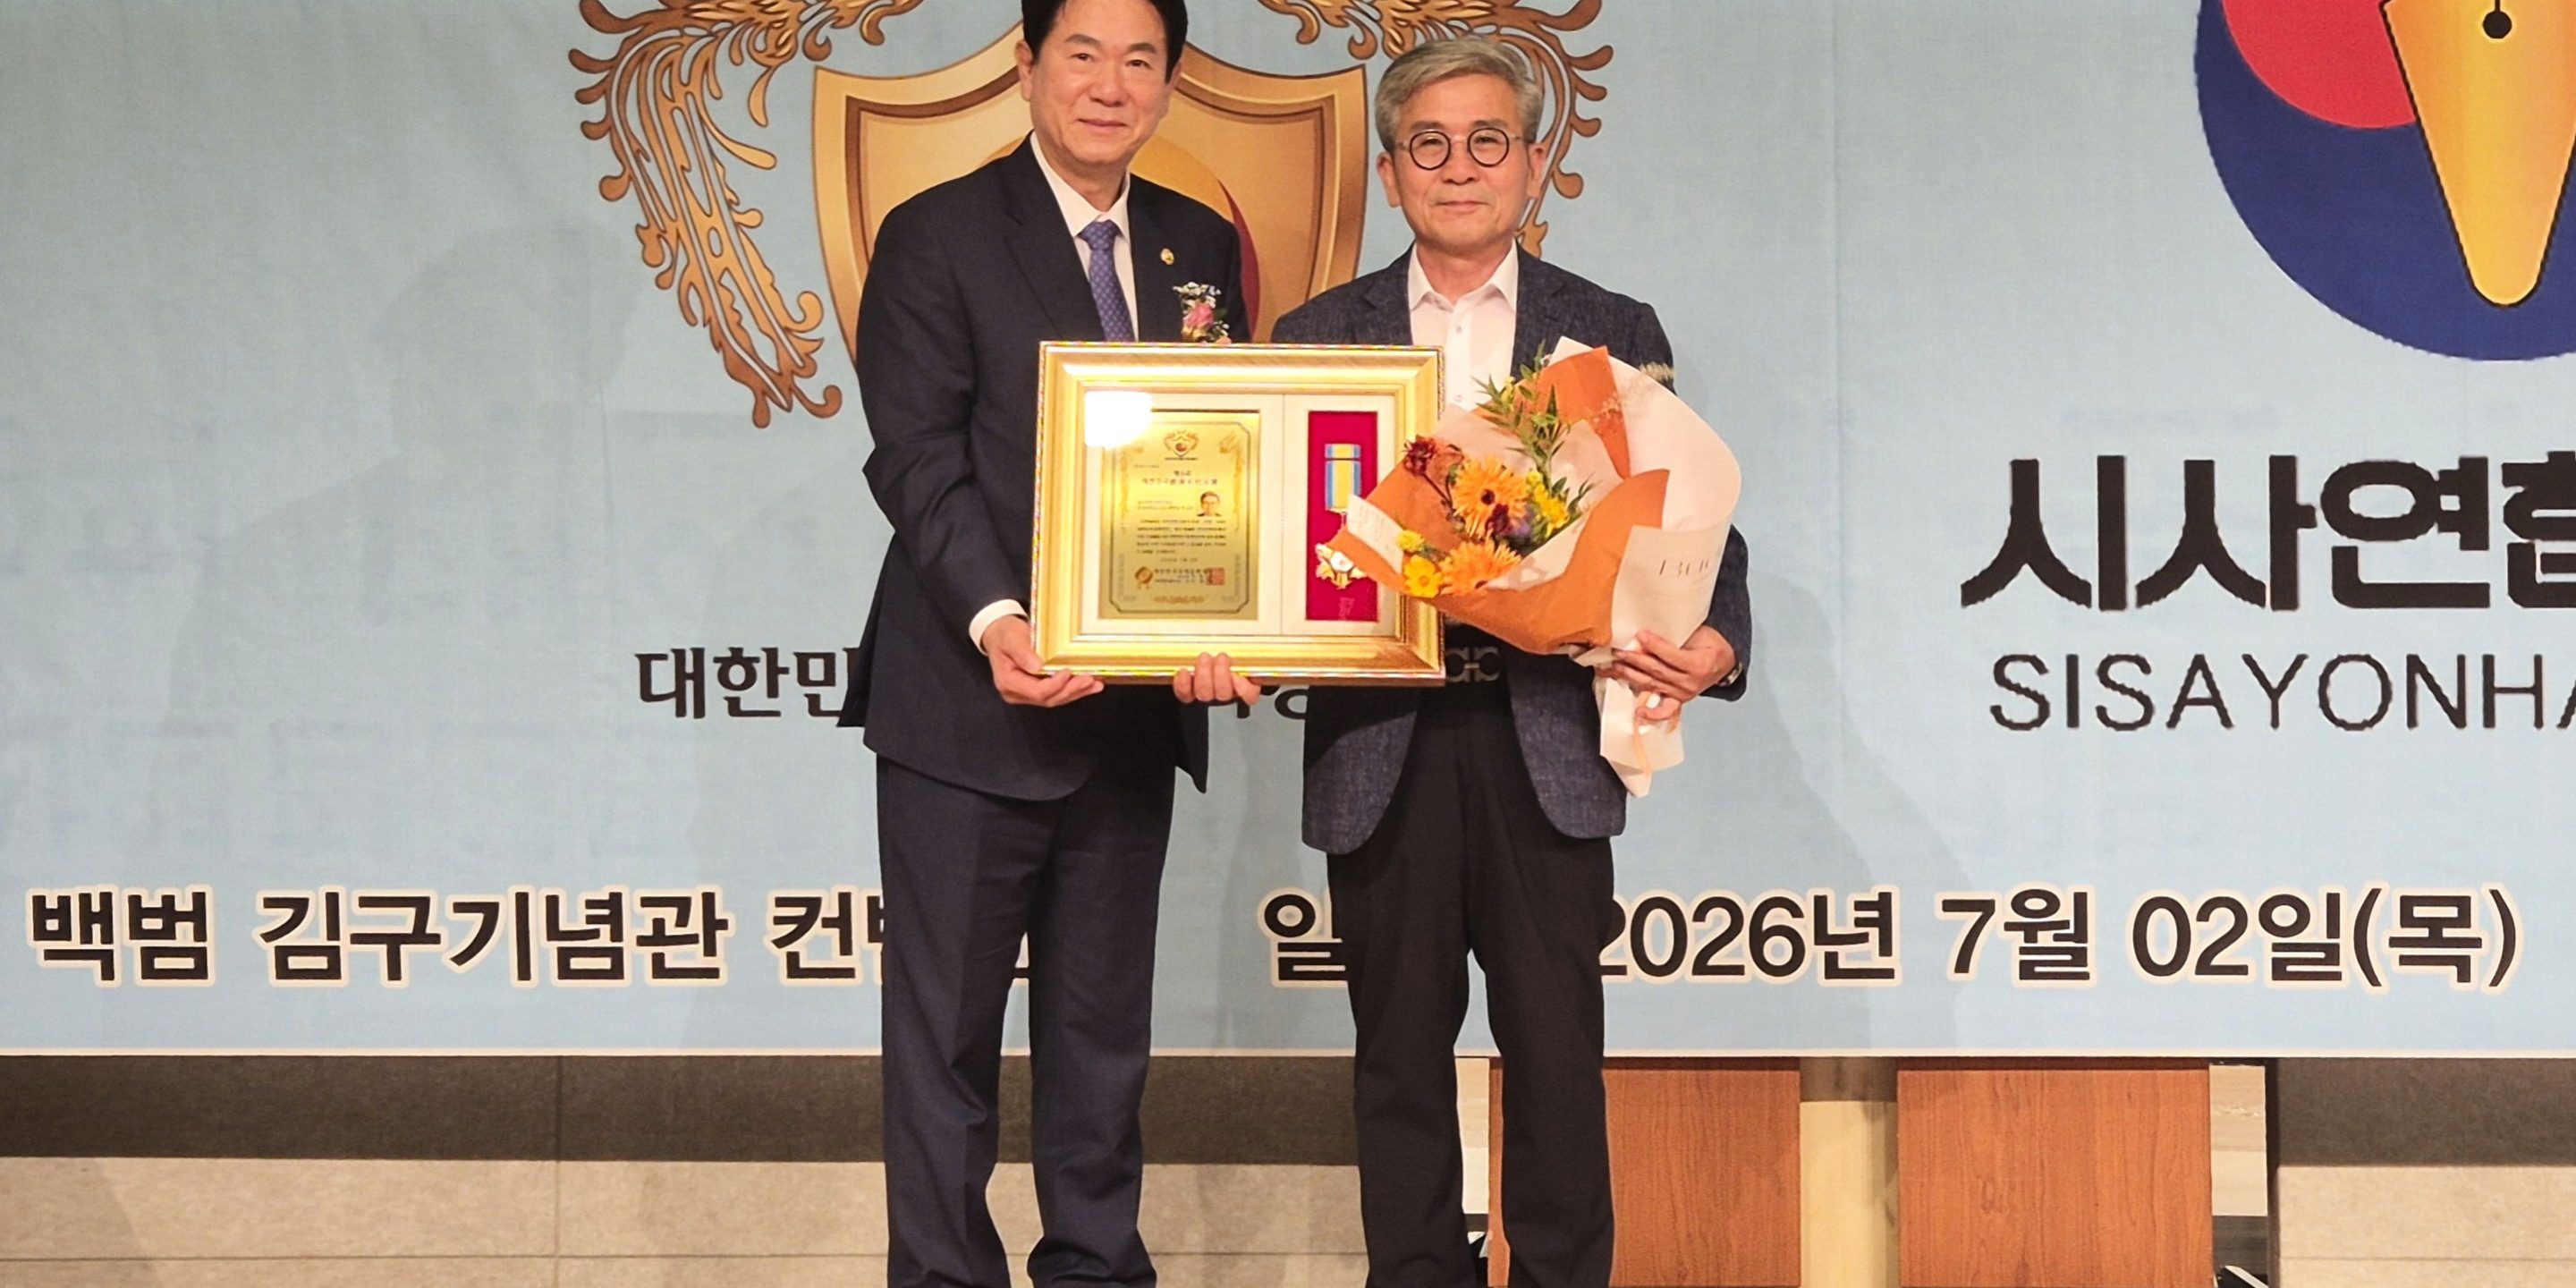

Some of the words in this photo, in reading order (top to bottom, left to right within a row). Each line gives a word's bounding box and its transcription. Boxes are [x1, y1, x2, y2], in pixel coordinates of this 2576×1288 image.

[1991, 654, 2576, 731] SISAYONH
[33, 892, 208, 981] 백범
[261, 892, 728, 981] 김구기념관
[772, 892, 884, 981] 컨
[1943, 890, 2090, 980] 7월
[2133, 888, 2516, 987] 02일(목)
